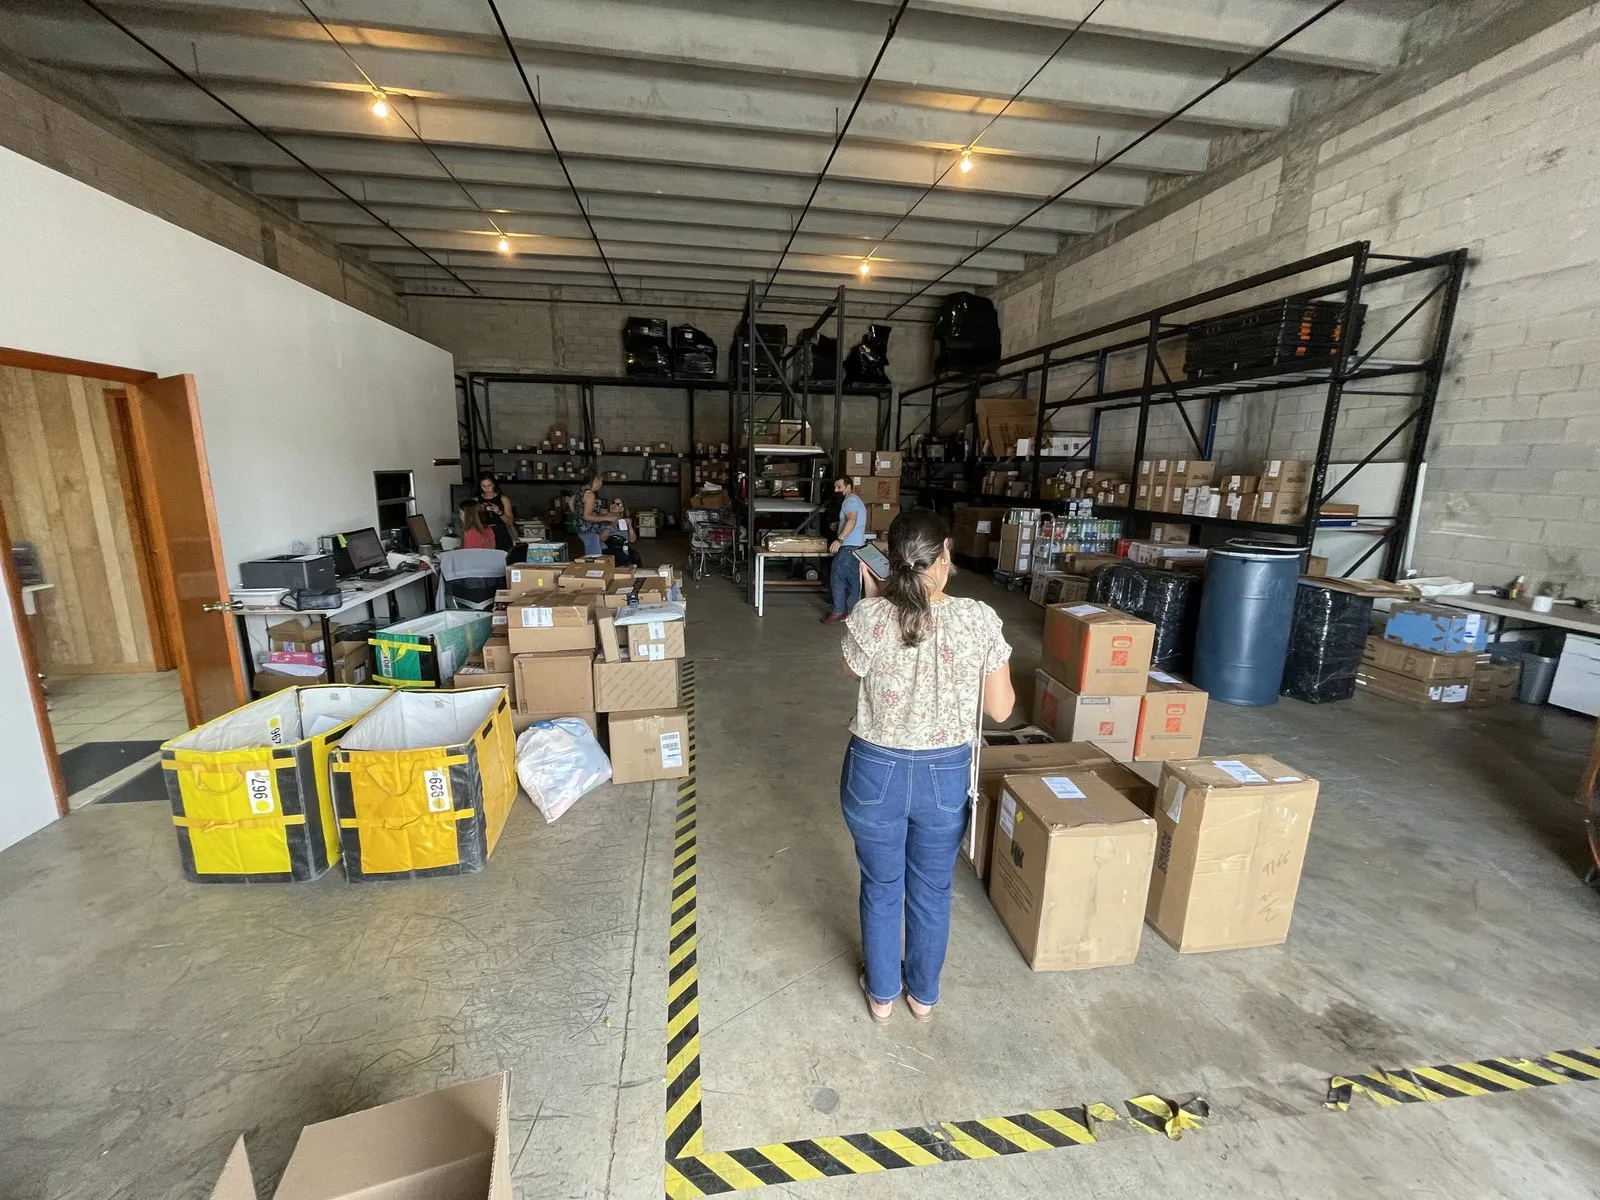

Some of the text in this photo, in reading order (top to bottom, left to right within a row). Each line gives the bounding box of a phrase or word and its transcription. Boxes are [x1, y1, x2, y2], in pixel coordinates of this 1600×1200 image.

[271, 727, 282, 744] 967
[251, 778, 268, 800] 967
[429, 777, 444, 798] 929
